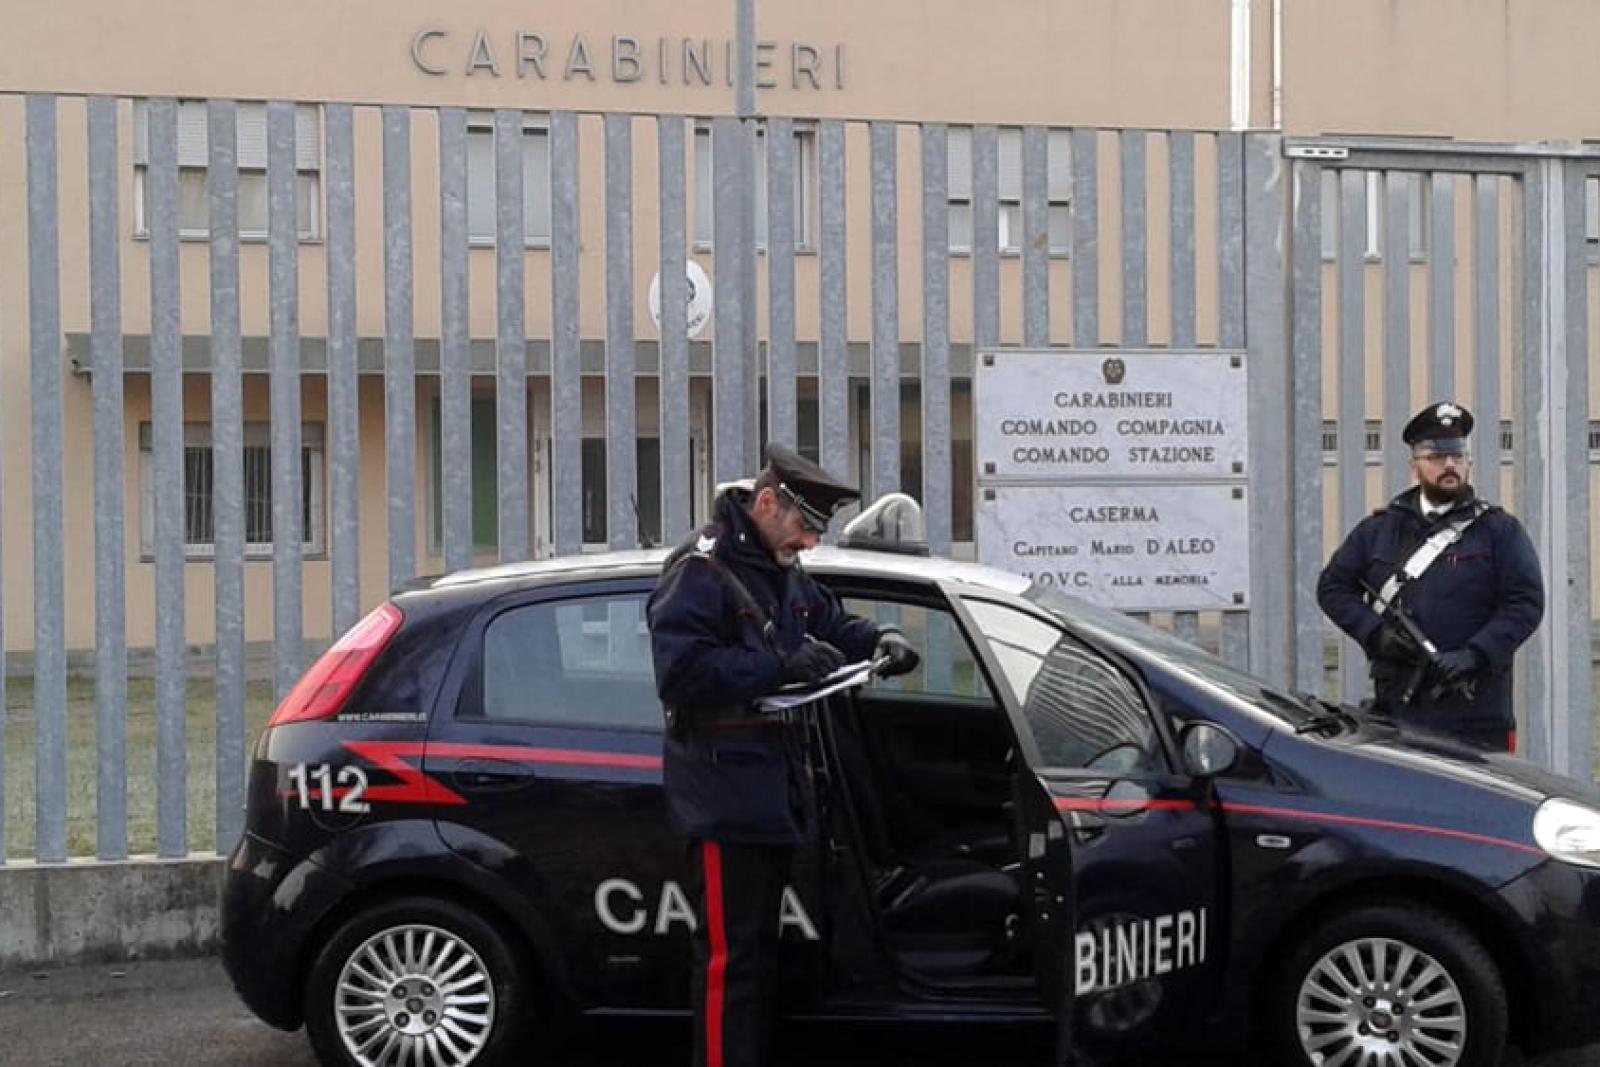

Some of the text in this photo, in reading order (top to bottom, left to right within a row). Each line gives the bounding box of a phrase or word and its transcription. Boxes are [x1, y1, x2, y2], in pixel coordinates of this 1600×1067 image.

[411, 28, 846, 91] CARABINIERI
[1053, 391, 1173, 408] CARABINIERI
[1001, 419, 1225, 436] COMANDO COMPAGNIA
[1012, 446, 1216, 463] COMANDO STAZIONE
[1069, 506, 1159, 523] CASERMA
[287, 761, 371, 814] 112
[594, 878, 821, 941] CAA
[1074, 906, 1207, 998] BINIERI
